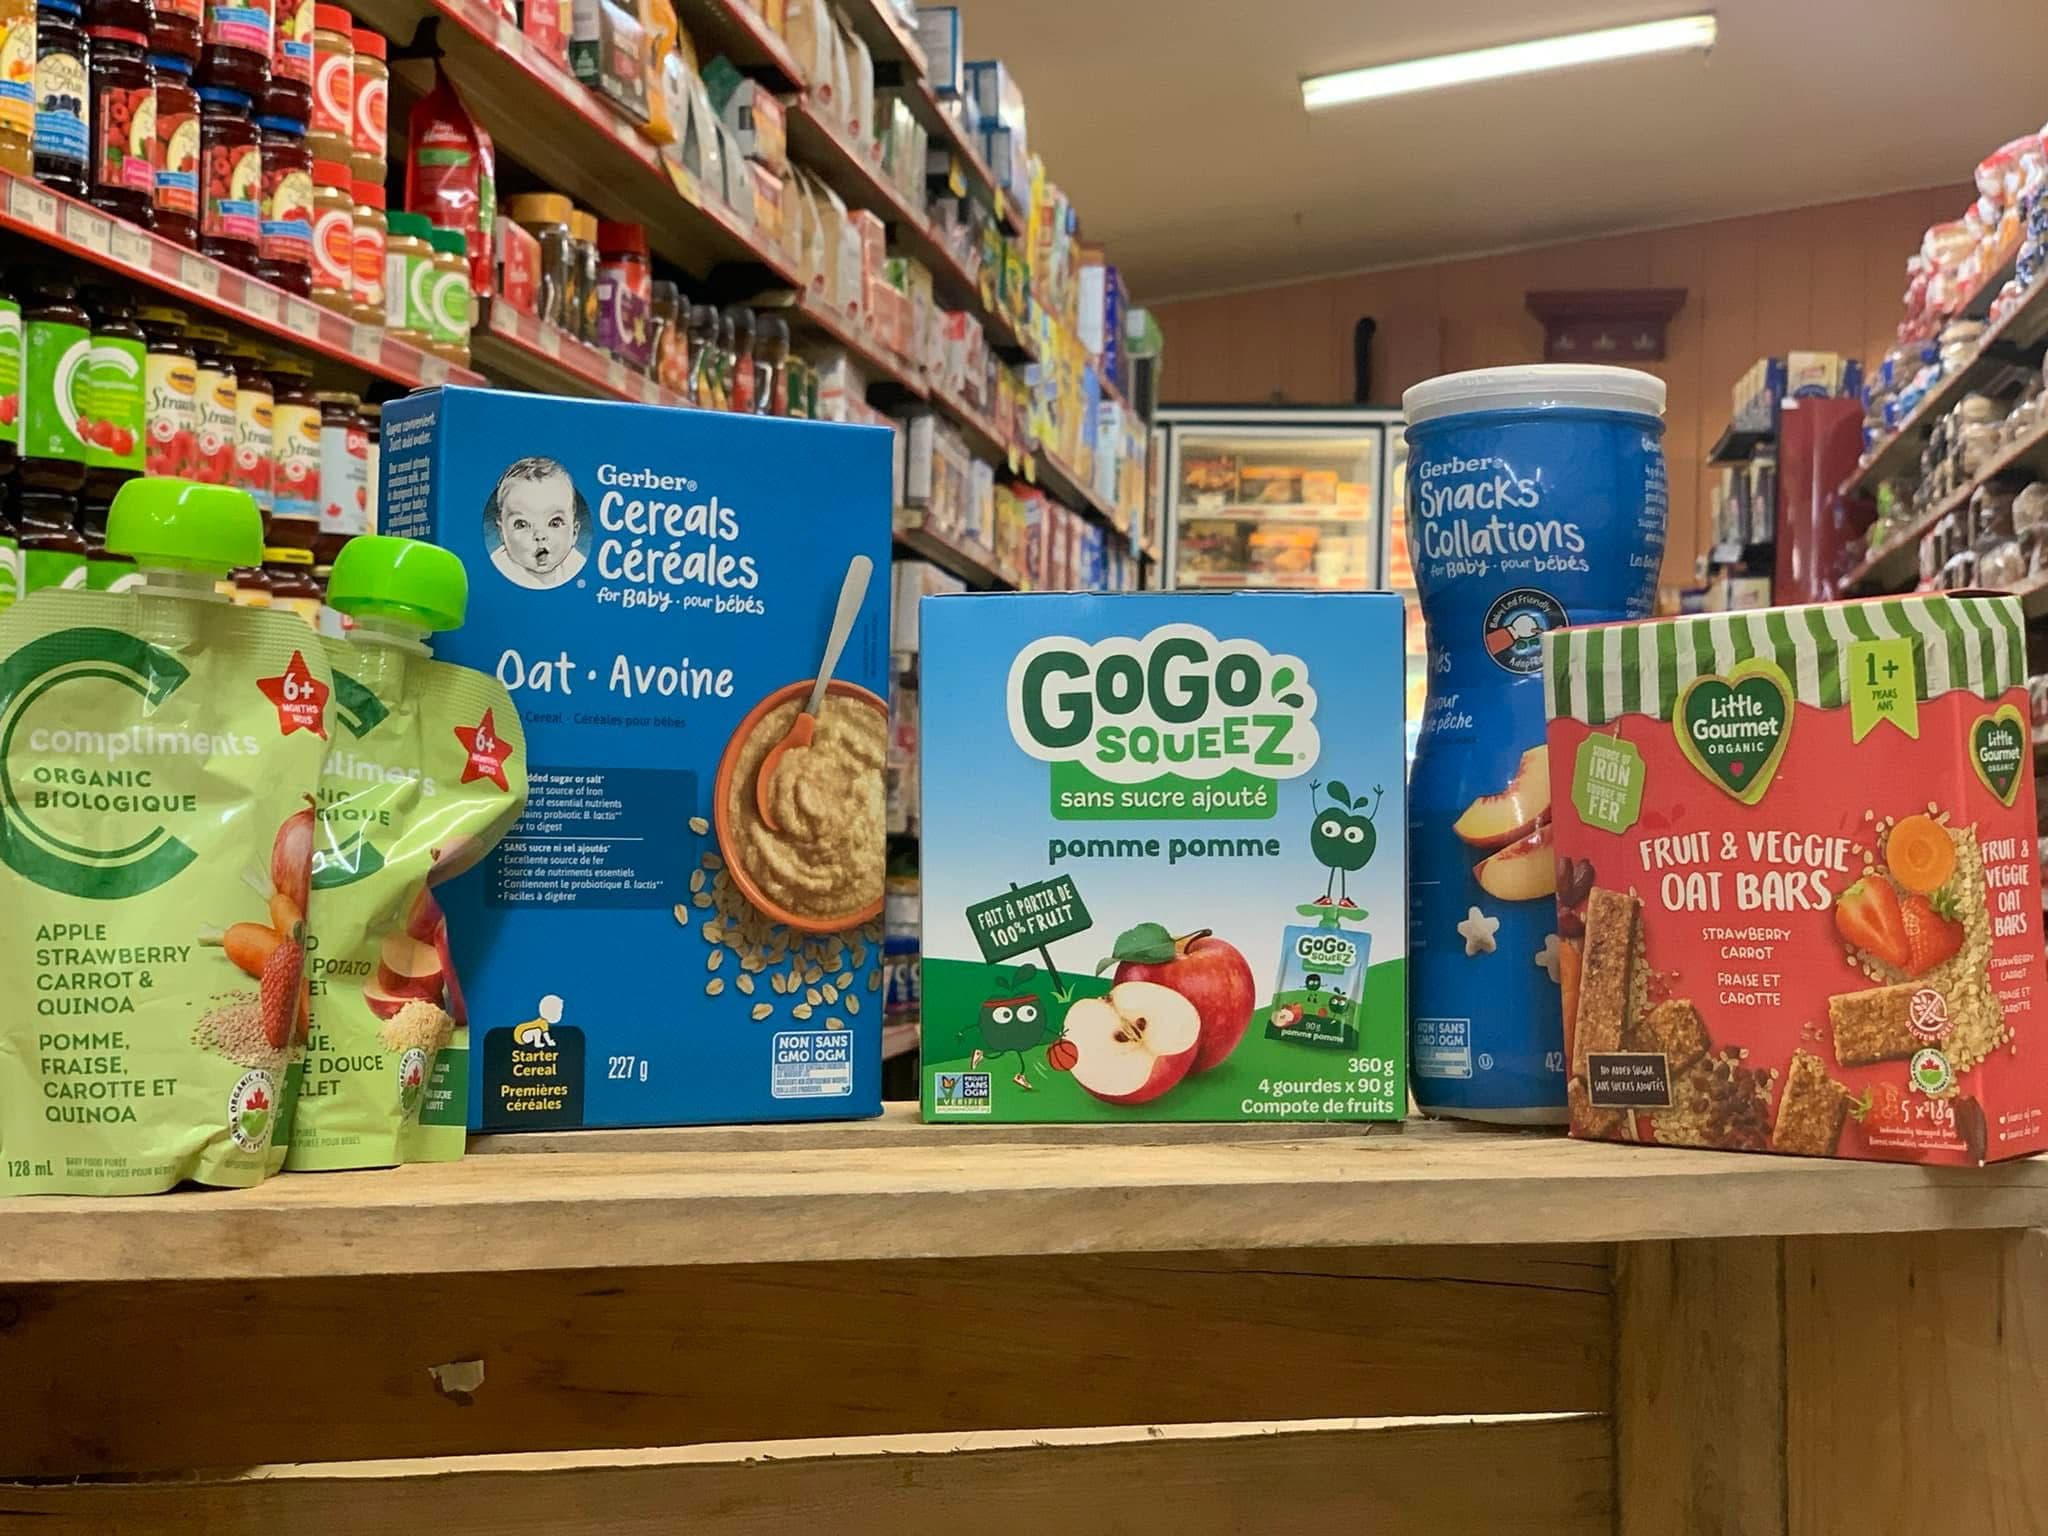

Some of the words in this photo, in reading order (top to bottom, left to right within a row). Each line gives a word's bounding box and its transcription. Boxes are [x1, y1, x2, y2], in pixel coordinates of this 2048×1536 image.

[1421, 476, 1540, 518] Snacks
[599, 491, 739, 541] Cereals
[1424, 515, 1584, 559] Collations
[597, 538, 759, 589] Céréales
[1446, 560, 1490, 578] Baby
[1501, 558, 1530, 574] pour
[1534, 554, 1589, 573] bébés
[596, 586, 621, 603] for
[622, 587, 673, 613] Baby
[683, 594, 713, 610] pour
[714, 594, 765, 615] bébés
[497, 649, 576, 695] Oat
[609, 654, 734, 699] Avoine
[1865, 652, 1899, 686] 1+
[282, 672, 315, 700] 6+
[1022, 638, 1262, 748] GoGo
[1872, 688, 1898, 700] YEARS
[1711, 694, 1763, 719] Little
[1877, 700, 1894, 712] ANS
[1693, 717, 1778, 740] Gourmet
[1987, 730, 2013, 747] Little
[30, 724, 261, 762] compliments
[474, 726, 496, 753] 6+
[1708, 742, 1765, 755] ORGANIC
[1980, 746, 2020, 763] Gourmet
[34, 766, 152, 788] ORGANIC
[1589, 756, 1631, 787] IRON
[35, 790, 197, 812] BIOLOGIQUE
[1060, 789, 1114, 807] sans
[1121, 789, 1185, 807] sucre
[1191, 784, 1268, 812] ajouté
[1588, 794, 1620, 823] FER
[1048, 838, 1160, 865] pomme
[1168, 837, 1280, 865] pomme
[1640, 831, 1711, 872] FRUIT
[1720, 832, 1738, 860] &
[1747, 831, 1851, 872] VEGGIE
[1981, 838, 2015, 863] FRUIT
[2021, 839, 2029, 857] &
[1986, 864, 2029, 888] VEGGIE
[1660, 871, 1723, 911] OAT
[1736, 869, 1832, 911] BARS
[977, 908, 1003, 931] FAIT
[1003, 899, 1015, 920] À
[1016, 891, 1056, 917] PARTIR
[1057, 883, 1073, 902] DE
[1998, 889, 2021, 912] OAT
[36, 924, 107, 941] APPLE
[989, 919, 1027, 948] 100%
[1028, 904, 1073, 936] FRUIT
[1702, 927, 1791, 941] STRAWBERRY
[1995, 912, 2027, 937] BARS
[36, 946, 191, 966] STRAWBERRY
[1298, 937, 1347, 956] GoGo
[1720, 946, 1774, 960] CARROT
[313, 957, 372, 976] POTATO
[36, 971, 133, 991] CARROT
[139, 971, 153, 988] &
[1717, 972, 1759, 987] FRAISE
[1763, 974, 1780, 987] ET
[37, 996, 135, 1016] QUINOA
[1719, 991, 1781, 1006] CAROTTE
[1438, 1022, 1465, 1034] SANS
[1905, 1020, 1935, 1041] GLUTEN
[39, 1032, 130, 1051] POMME,
[779, 1036, 810, 1049] NON
[815, 1035, 848, 1047] SANS
[1438, 1034, 1465, 1046] OGM
[320, 1055, 384, 1074] DOUCE
[511, 1050, 559, 1063] Starter
[778, 1050, 810, 1062] GMO
[815, 1049, 846, 1061] OGM
[41, 1056, 128, 1075] FRAISE,
[512, 1063, 557, 1077] Cereal
[607, 1056, 635, 1080] 227
[639, 1060, 648, 1082] g
[1348, 1058, 1380, 1073] 360
[1383, 1061, 1394, 1077] g
[44, 1080, 146, 1099] CAROTTE
[152, 1079, 177, 1097] ET
[501, 1084, 568, 1098] Premières
[964, 1089, 988, 1097] OGM
[1258, 1079, 1270, 1093] 4
[1272, 1078, 1342, 1098] gourdes
[1345, 1082, 1355, 1093] x
[1358, 1078, 1380, 1093] 90
[1383, 1081, 1394, 1098] g
[506, 1095, 562, 1112] céréales
[1241, 1098, 1320, 1118] Compote
[1323, 1098, 1345, 1114] de
[1347, 1098, 1394, 1114] fruits
[45, 1105, 137, 1123] QUINOA
[8, 1160, 30, 1177] 128
[35, 1160, 53, 1176] mL
